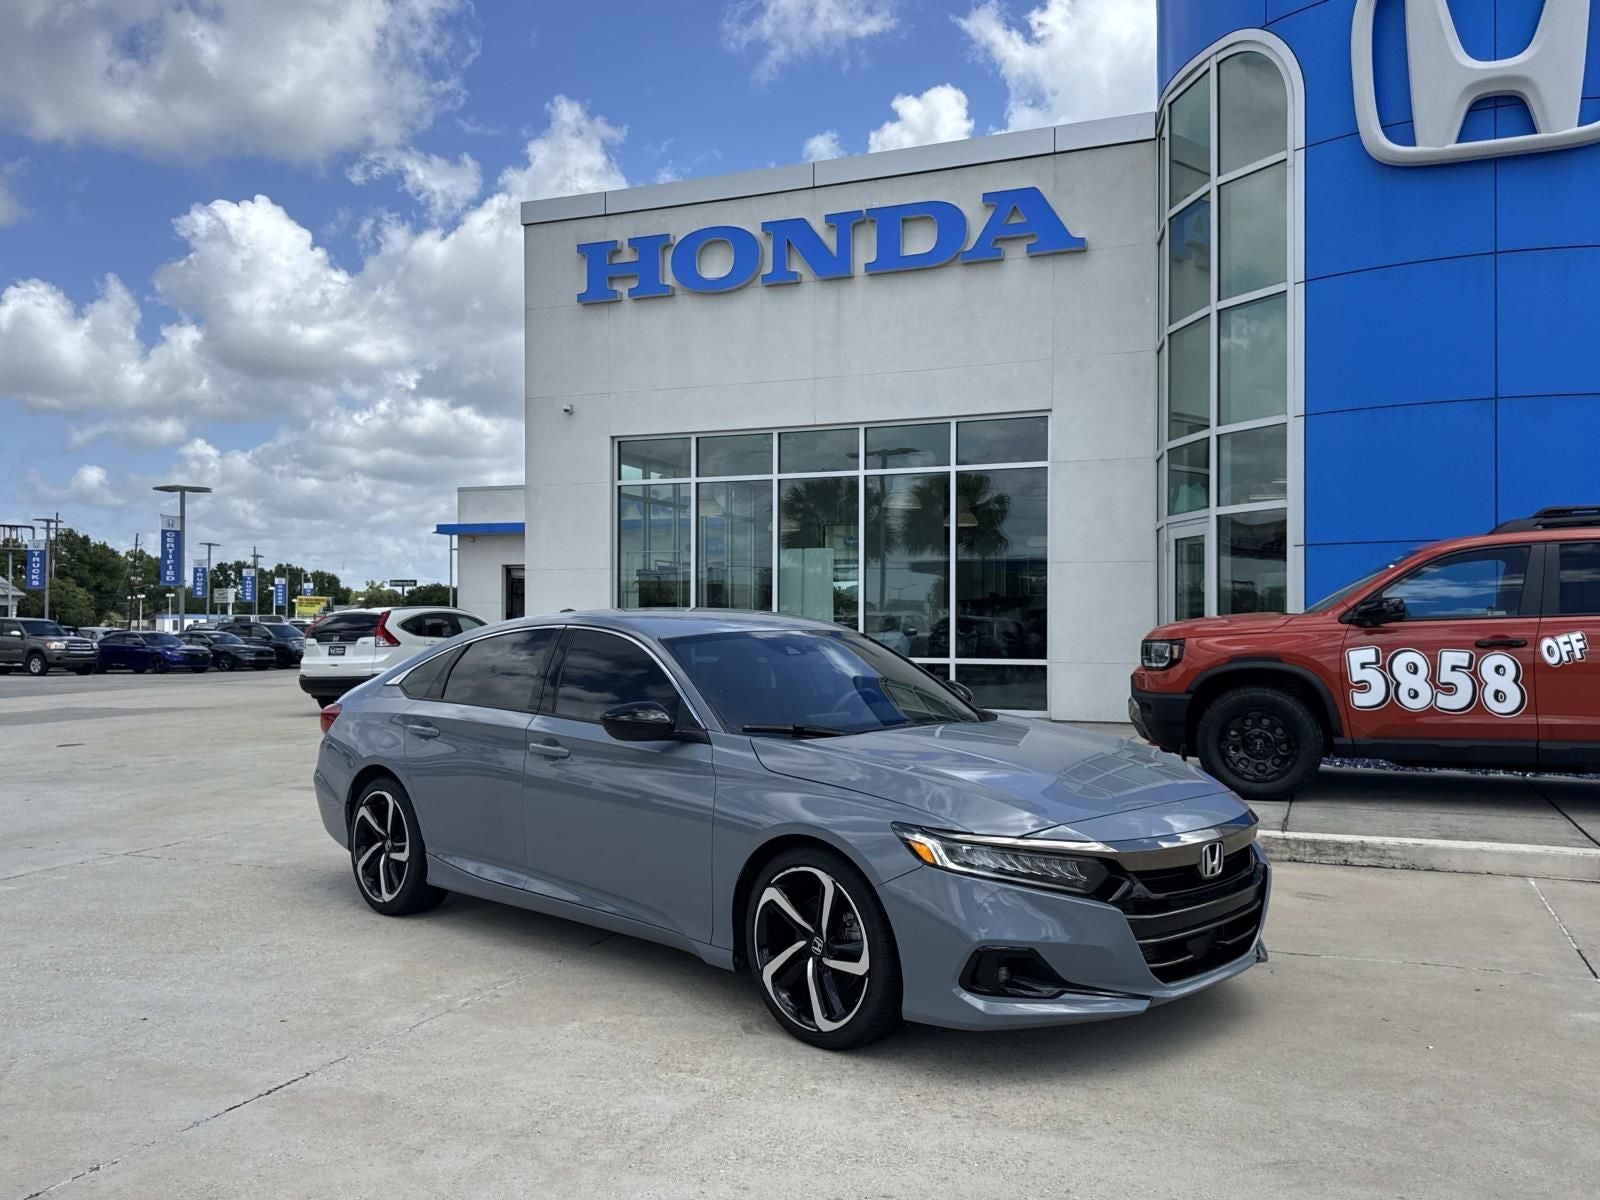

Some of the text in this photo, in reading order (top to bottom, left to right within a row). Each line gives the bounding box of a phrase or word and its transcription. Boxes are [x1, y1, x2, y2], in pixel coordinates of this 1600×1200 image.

[577, 187, 1087, 304] HONDA
[31, 550, 40, 586] TRUCKS
[166, 532, 175, 582] CERTIFIED
[1541, 631, 1588, 667] OFF
[1346, 646, 1527, 717] 5858
